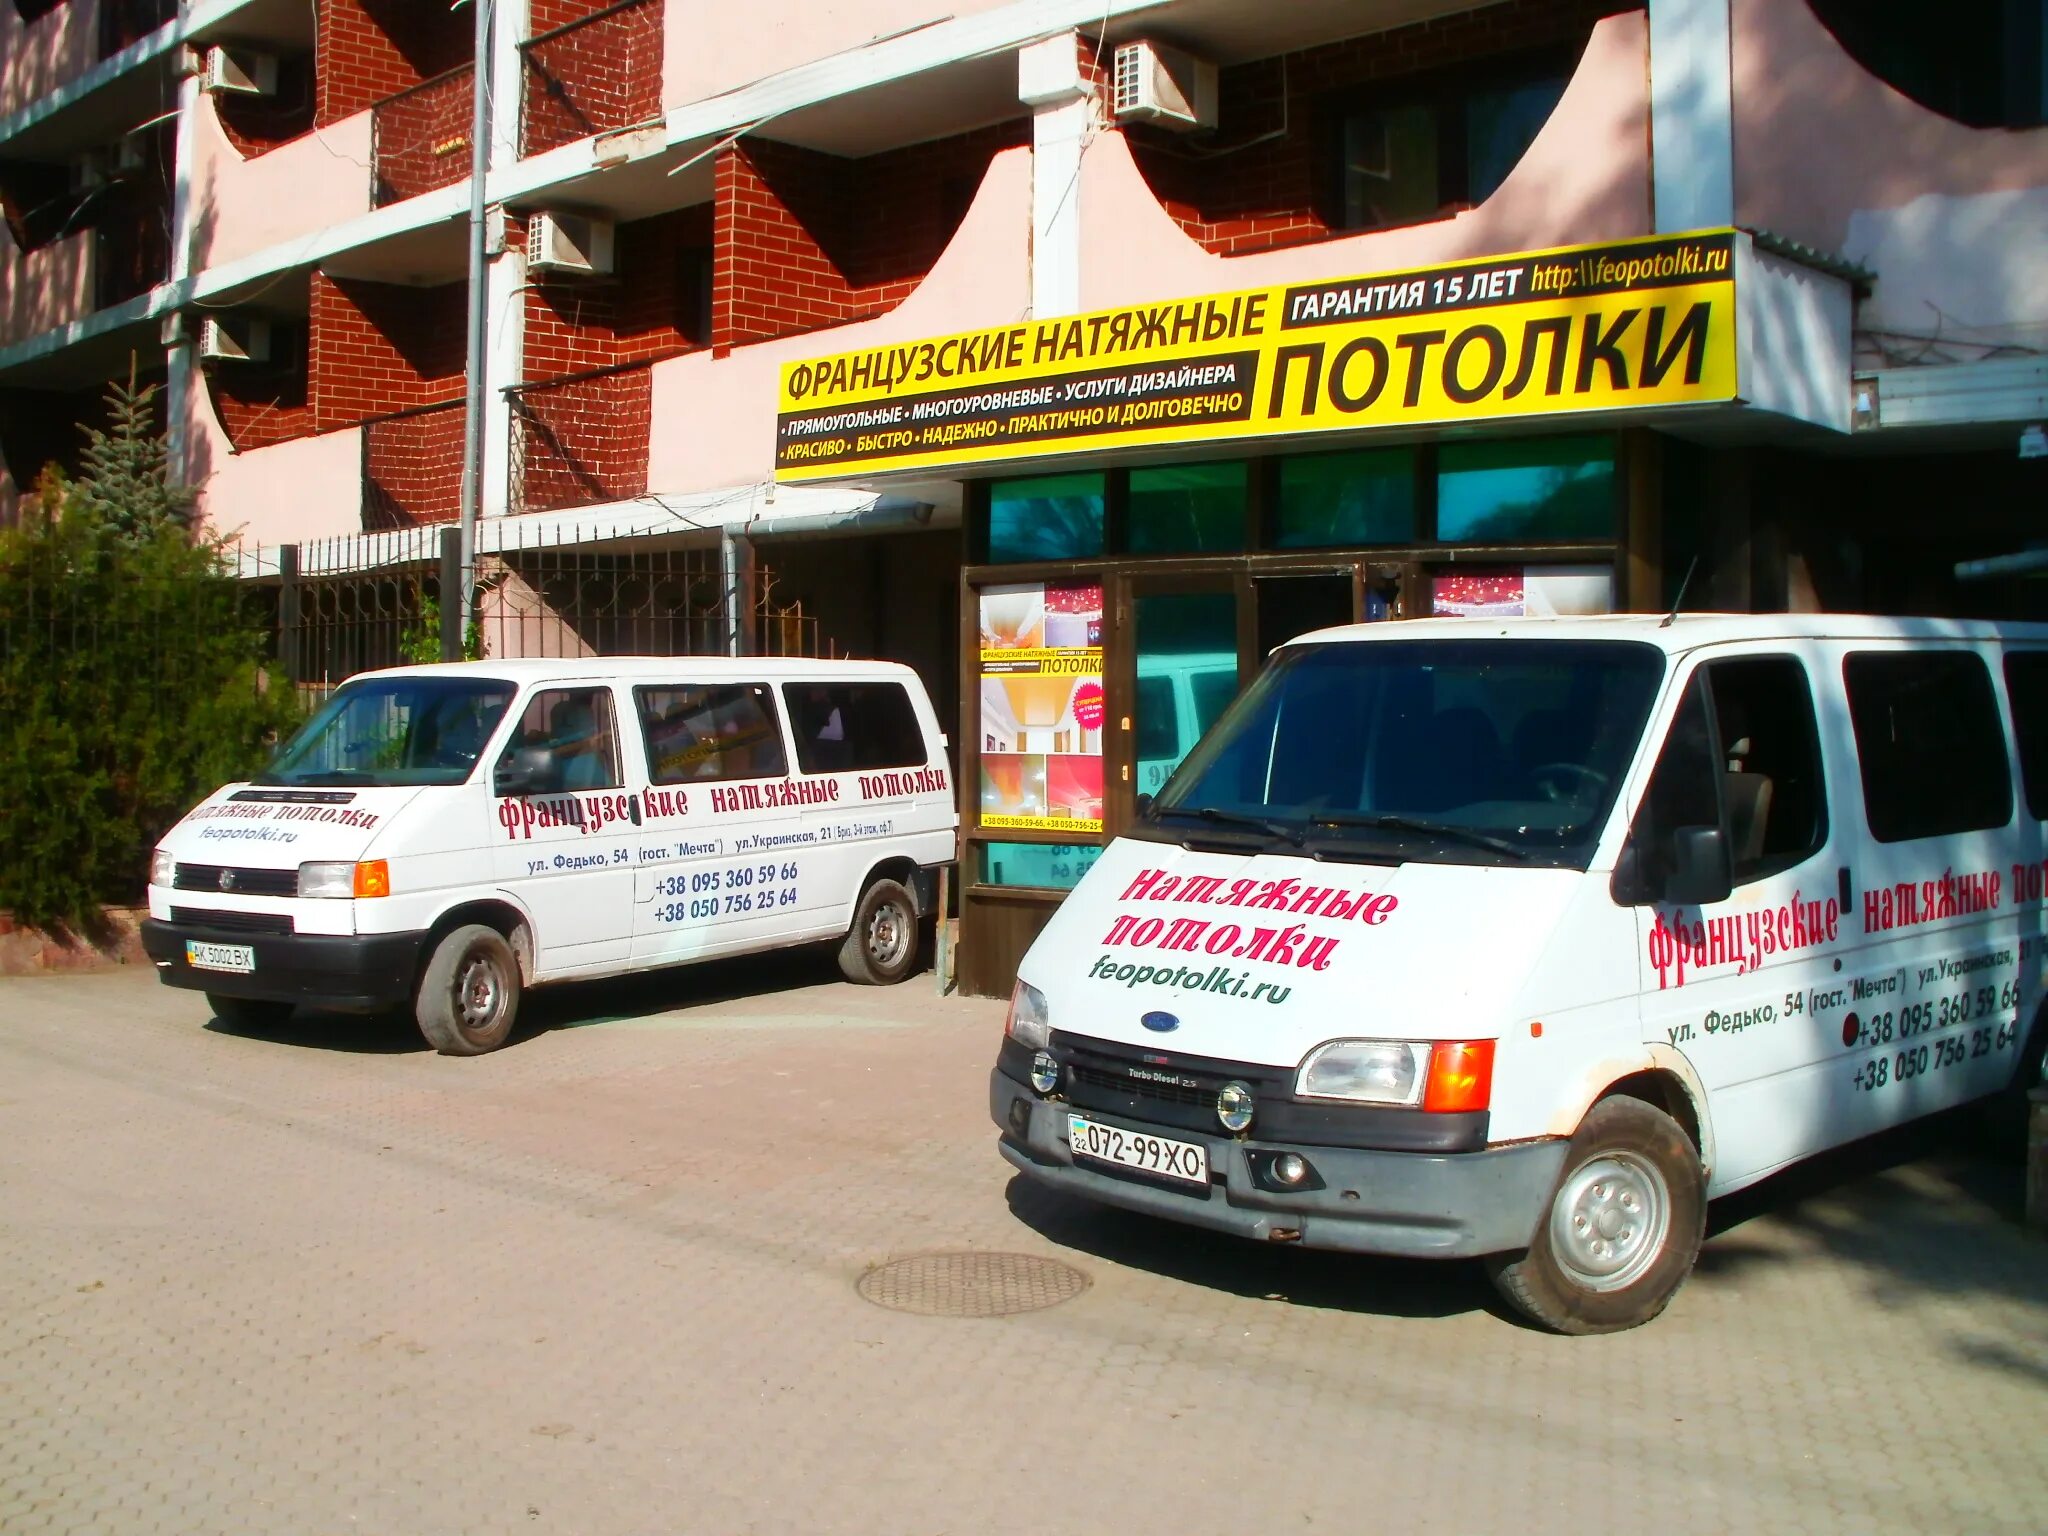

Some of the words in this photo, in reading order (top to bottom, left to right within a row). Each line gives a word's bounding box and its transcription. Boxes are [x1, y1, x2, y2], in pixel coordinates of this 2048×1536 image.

[1291, 283, 1425, 322] ГАРАНТИЯ
[1432, 276, 1462, 305] 15
[1467, 268, 1524, 301] ЛЕТ
[788, 327, 1027, 400] ФРАНЦУЗСКИЕ
[1032, 293, 1269, 364] НАТЯЖНЫЕ
[1267, 301, 1712, 420] ПОТОЛКИ
[788, 407, 902, 435] ПРЯМОУГОЛЬНЫЕ
[912, 386, 1053, 421] МНОГОУРОВНЕВЫЕ
[1064, 376, 1126, 401] УСЛУГИ
[1128, 363, 1237, 396] ДИЗАЙНЕРА
[786, 438, 846, 462] КРАСИВО
[857, 430, 913, 453] БЫСТРО
[922, 420, 998, 446] НАДЕЖНО
[1007, 407, 1104, 435] ПРАКТИЧНО
[1106, 405, 1120, 424] И
[1121, 392, 1243, 425] ДОЛГОВЕЧНО
[273, 805, 380, 830] потолки
[498, 786, 688, 840] французские
[711, 775, 839, 814] натяжные
[859, 764, 948, 801] потолки
[199, 826, 298, 843] feopotolki.ru
[527, 858, 549, 876] ул.
[553, 851, 609, 870] Федько,
[613, 847, 629, 864] 54
[820, 827, 832, 840] 21
[655, 874, 686, 896] +38
[691, 869, 719, 893] 095
[725, 866, 753, 889] 360
[757, 864, 777, 885] 59
[779, 861, 798, 881] 66
[655, 900, 684, 922] +38
[690, 896, 718, 918] 050
[725, 892, 752, 914] 756
[757, 890, 775, 910] 25
[779, 887, 797, 907] 64
[1101, 914, 1341, 971] потолки
[1649, 887, 1838, 990] французские
[1864, 866, 2001, 934] натяжные
[208, 947, 233, 965] 5002
[1088, 955, 1292, 1004] feopotolki.ru
[1667, 1021, 1696, 1048] ул.
[1703, 1000, 1778, 1034] Федько,
[1784, 992, 1803, 1017] 54
[1859, 1012, 1893, 1046] +38
[1899, 1001, 1931, 1036] 095
[1938, 993, 1969, 1025] 360
[1975, 986, 1996, 1016] 59
[2001, 977, 2021, 1008] 66
[1128, 1067, 1151, 1080] Turbo
[1153, 1072, 1179, 1085] Diesel
[1853, 1057, 1888, 1092] +38
[1894, 1048, 1928, 1082] 050
[1933, 1037, 1966, 1071] 756
[1971, 1029, 1992, 1060] 25
[1996, 1019, 2017, 1051] 64
[1075, 1138, 1087, 1150] 22
